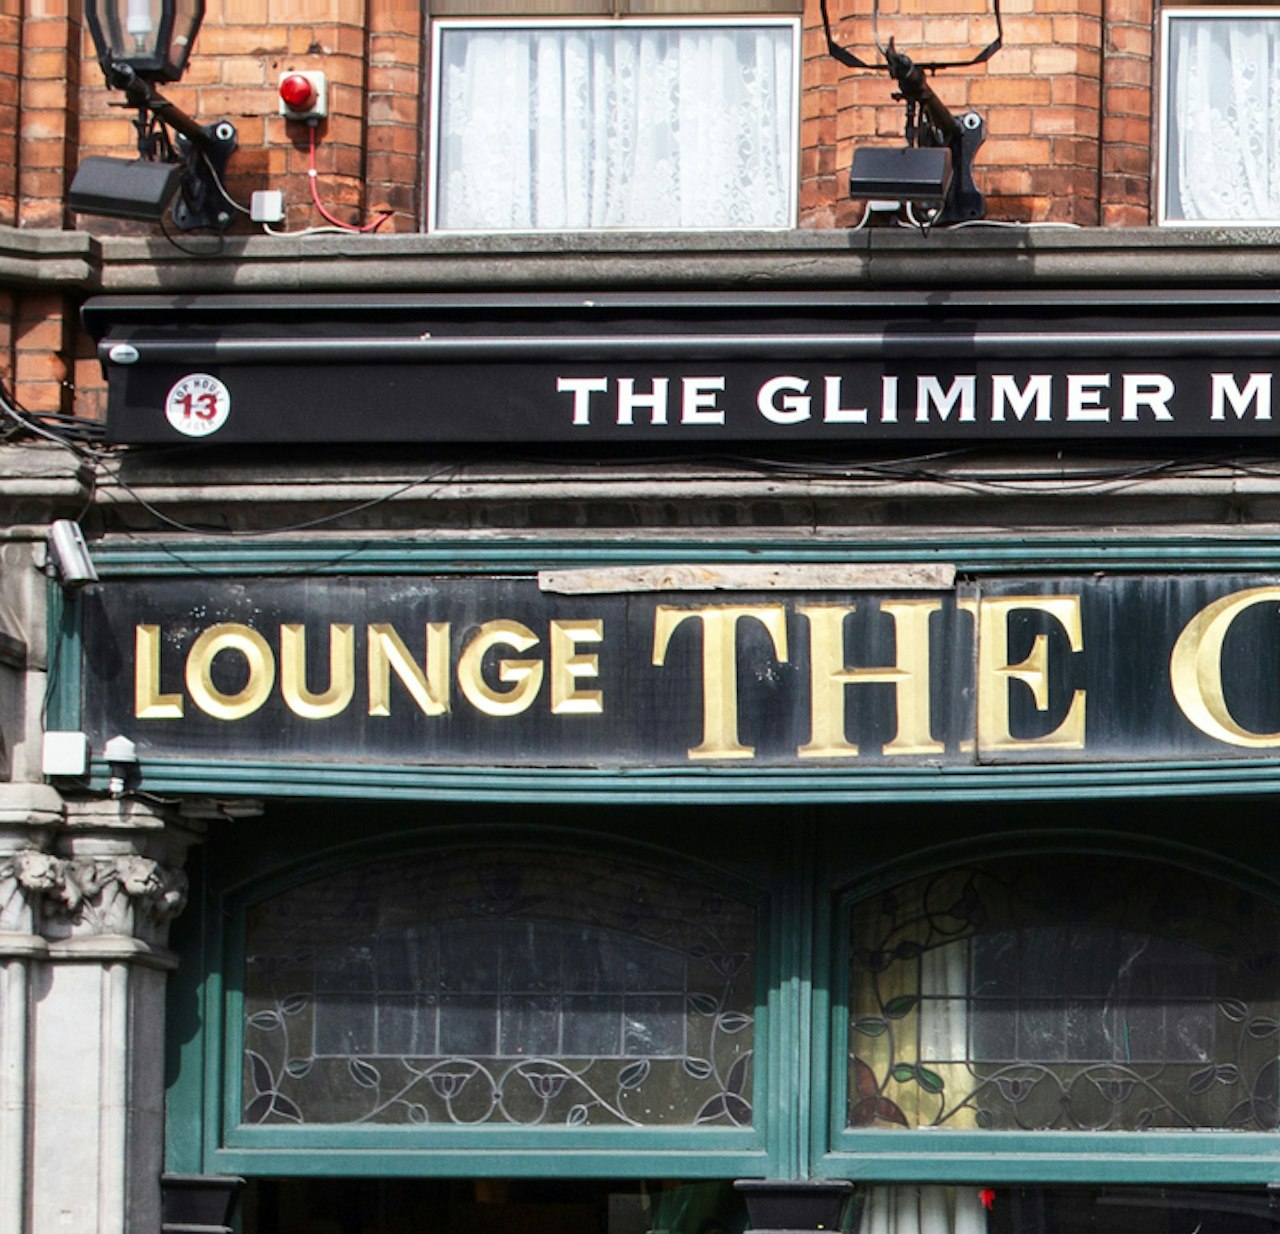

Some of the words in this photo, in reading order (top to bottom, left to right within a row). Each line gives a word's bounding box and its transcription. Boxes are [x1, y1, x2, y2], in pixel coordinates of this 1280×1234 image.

[177, 394, 218, 421] 13
[556, 376, 725, 425] THE
[757, 373, 1175, 424] GLIMMER
[135, 618, 603, 719] LOUNGE
[652, 594, 1087, 760] THE
